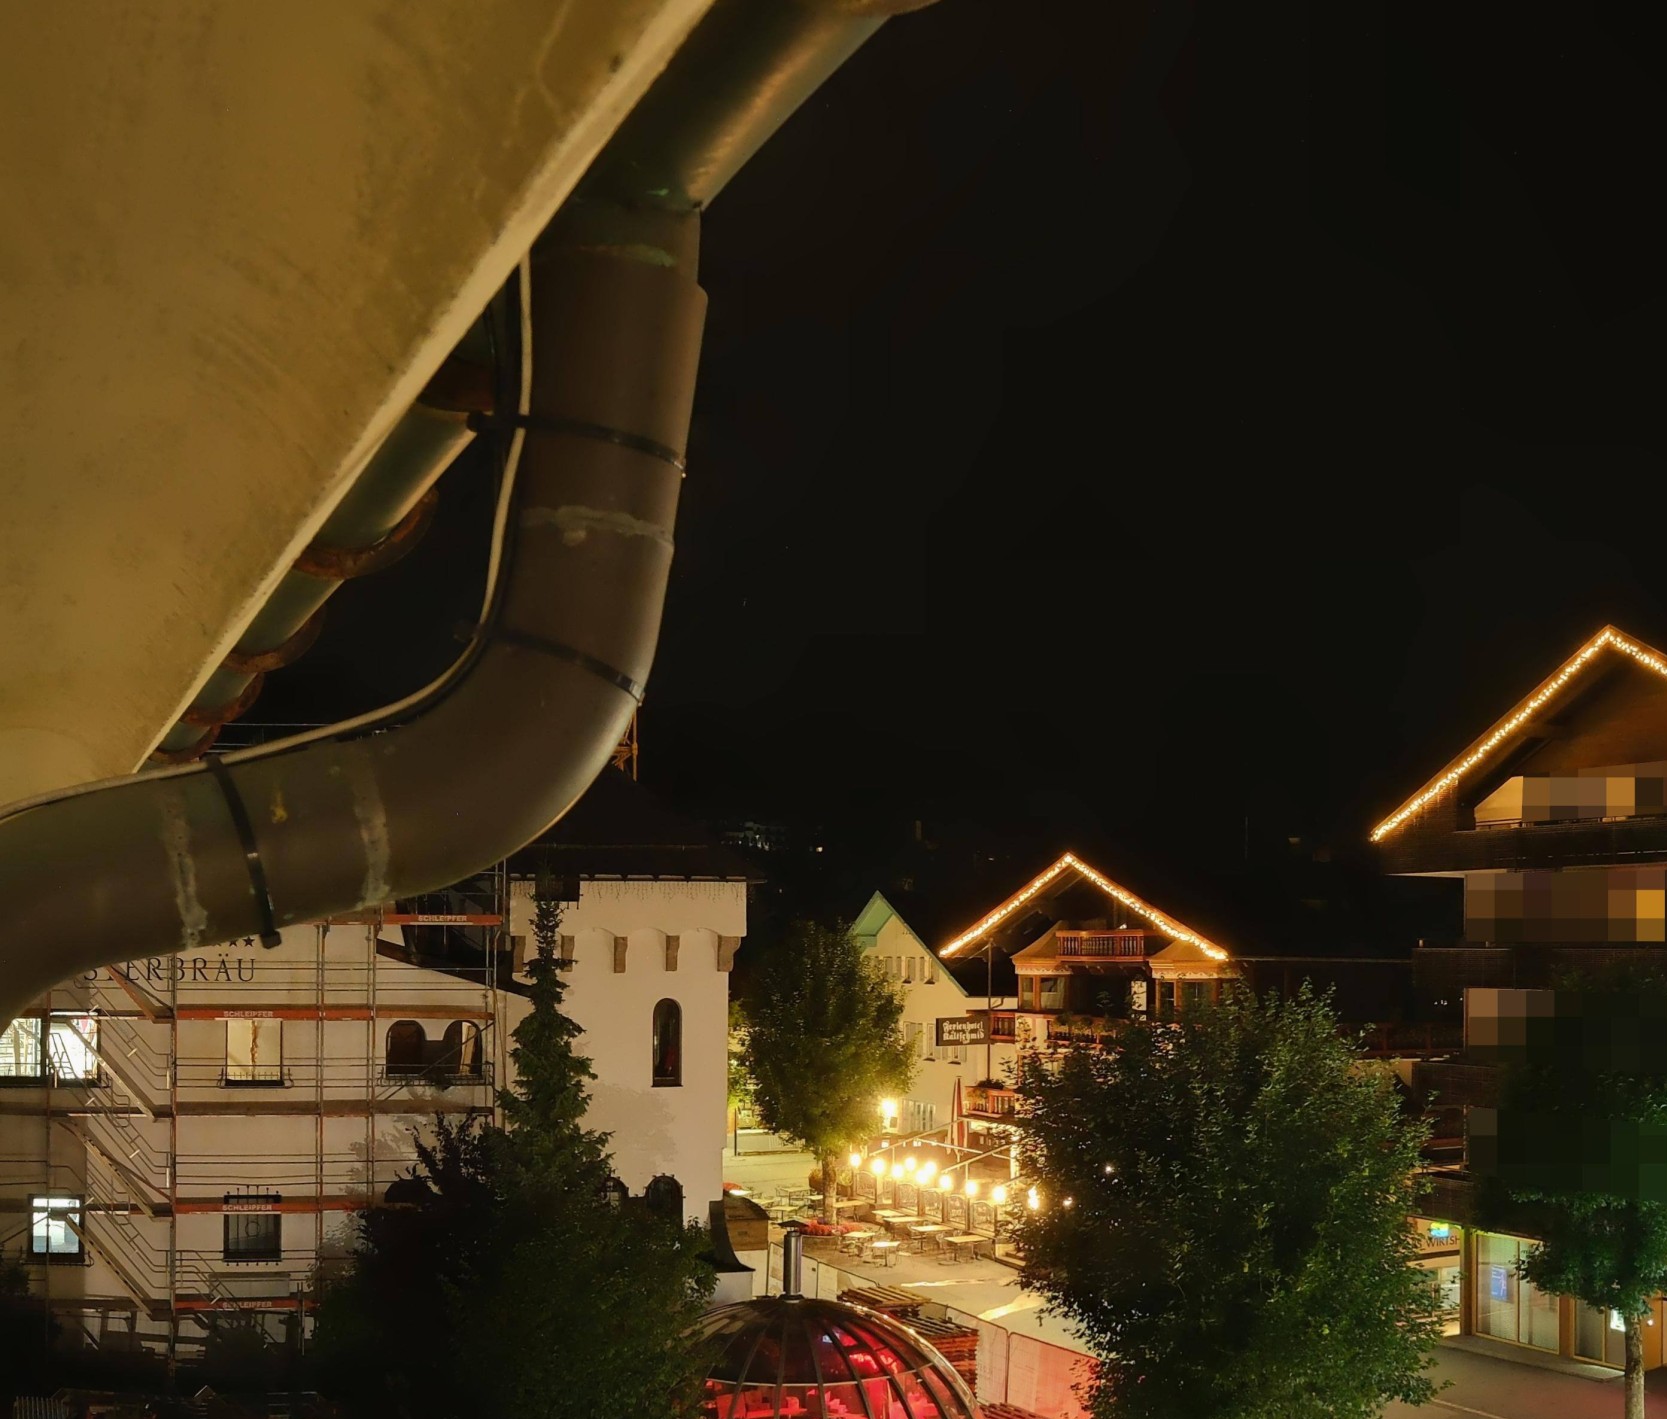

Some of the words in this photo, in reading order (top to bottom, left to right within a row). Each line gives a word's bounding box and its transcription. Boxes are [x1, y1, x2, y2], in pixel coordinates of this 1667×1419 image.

[223, 1010, 274, 1018] SCHLEIPFER
[222, 1204, 272, 1212] SCHLEIPFER
[222, 1301, 272, 1309] SCHLEIPFER
